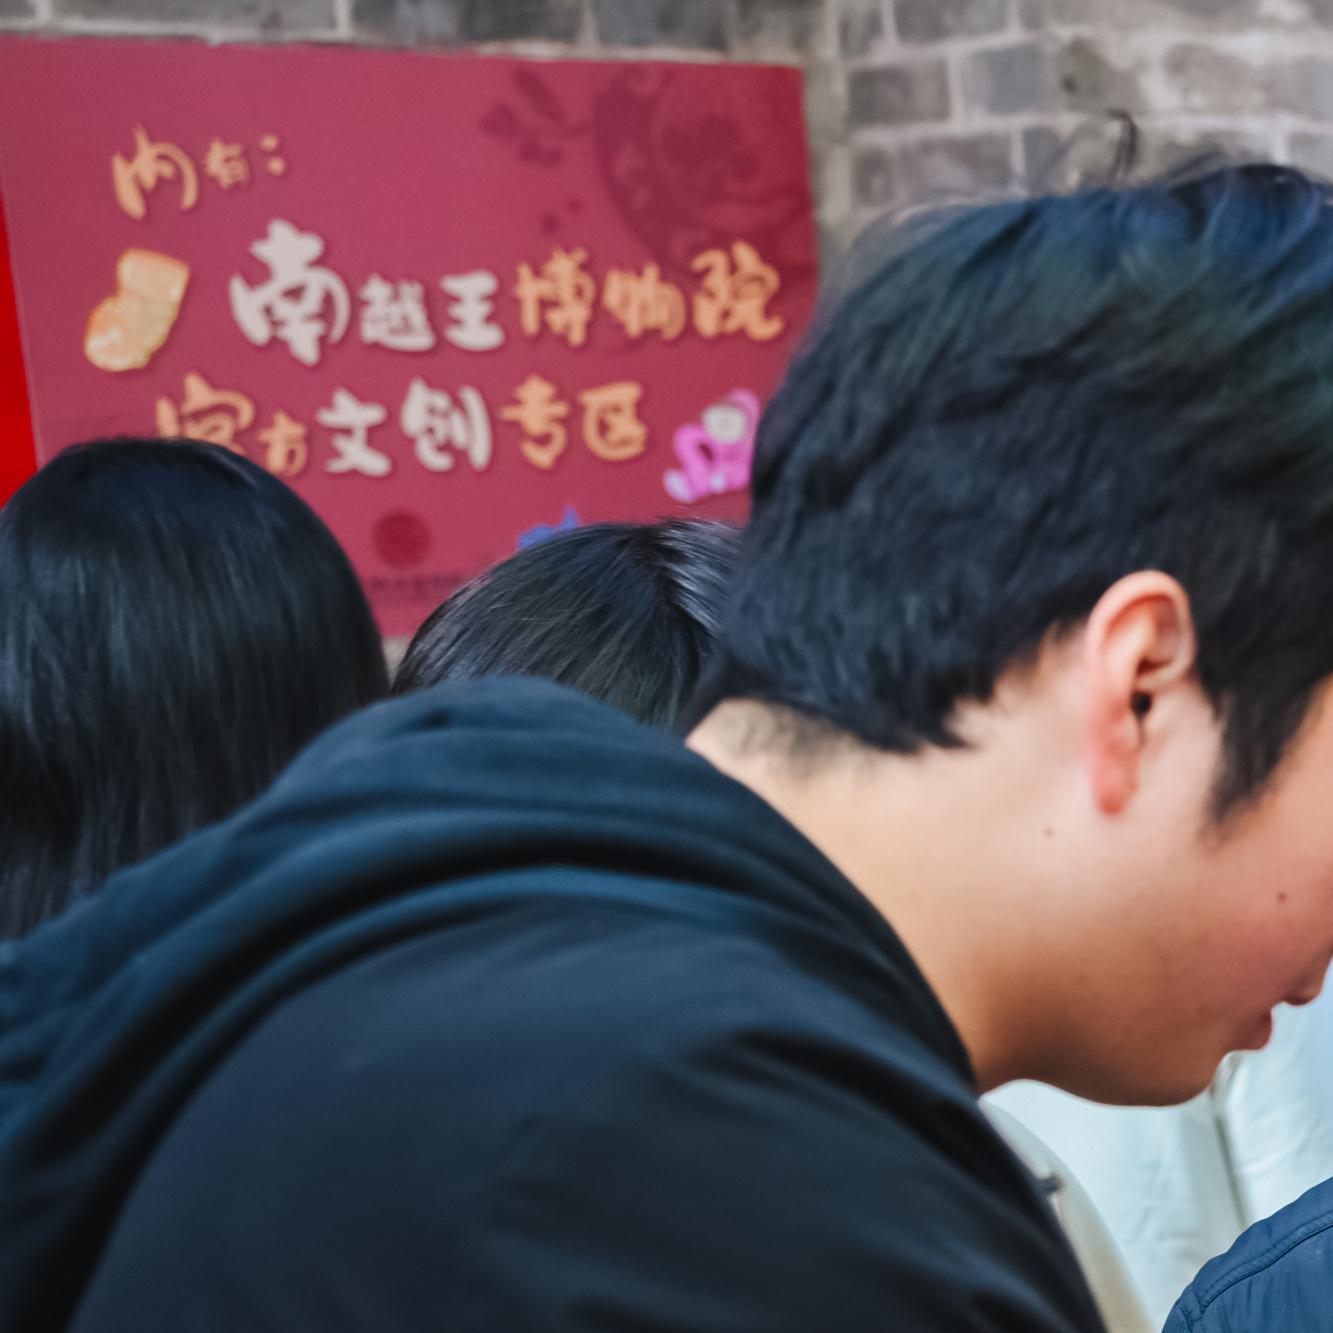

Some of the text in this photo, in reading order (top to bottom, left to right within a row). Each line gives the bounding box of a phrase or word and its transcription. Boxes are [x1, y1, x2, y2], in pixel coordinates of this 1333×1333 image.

[228, 216, 784, 367] 南越王博物院
[157, 372, 649, 478] 官方文创专区
